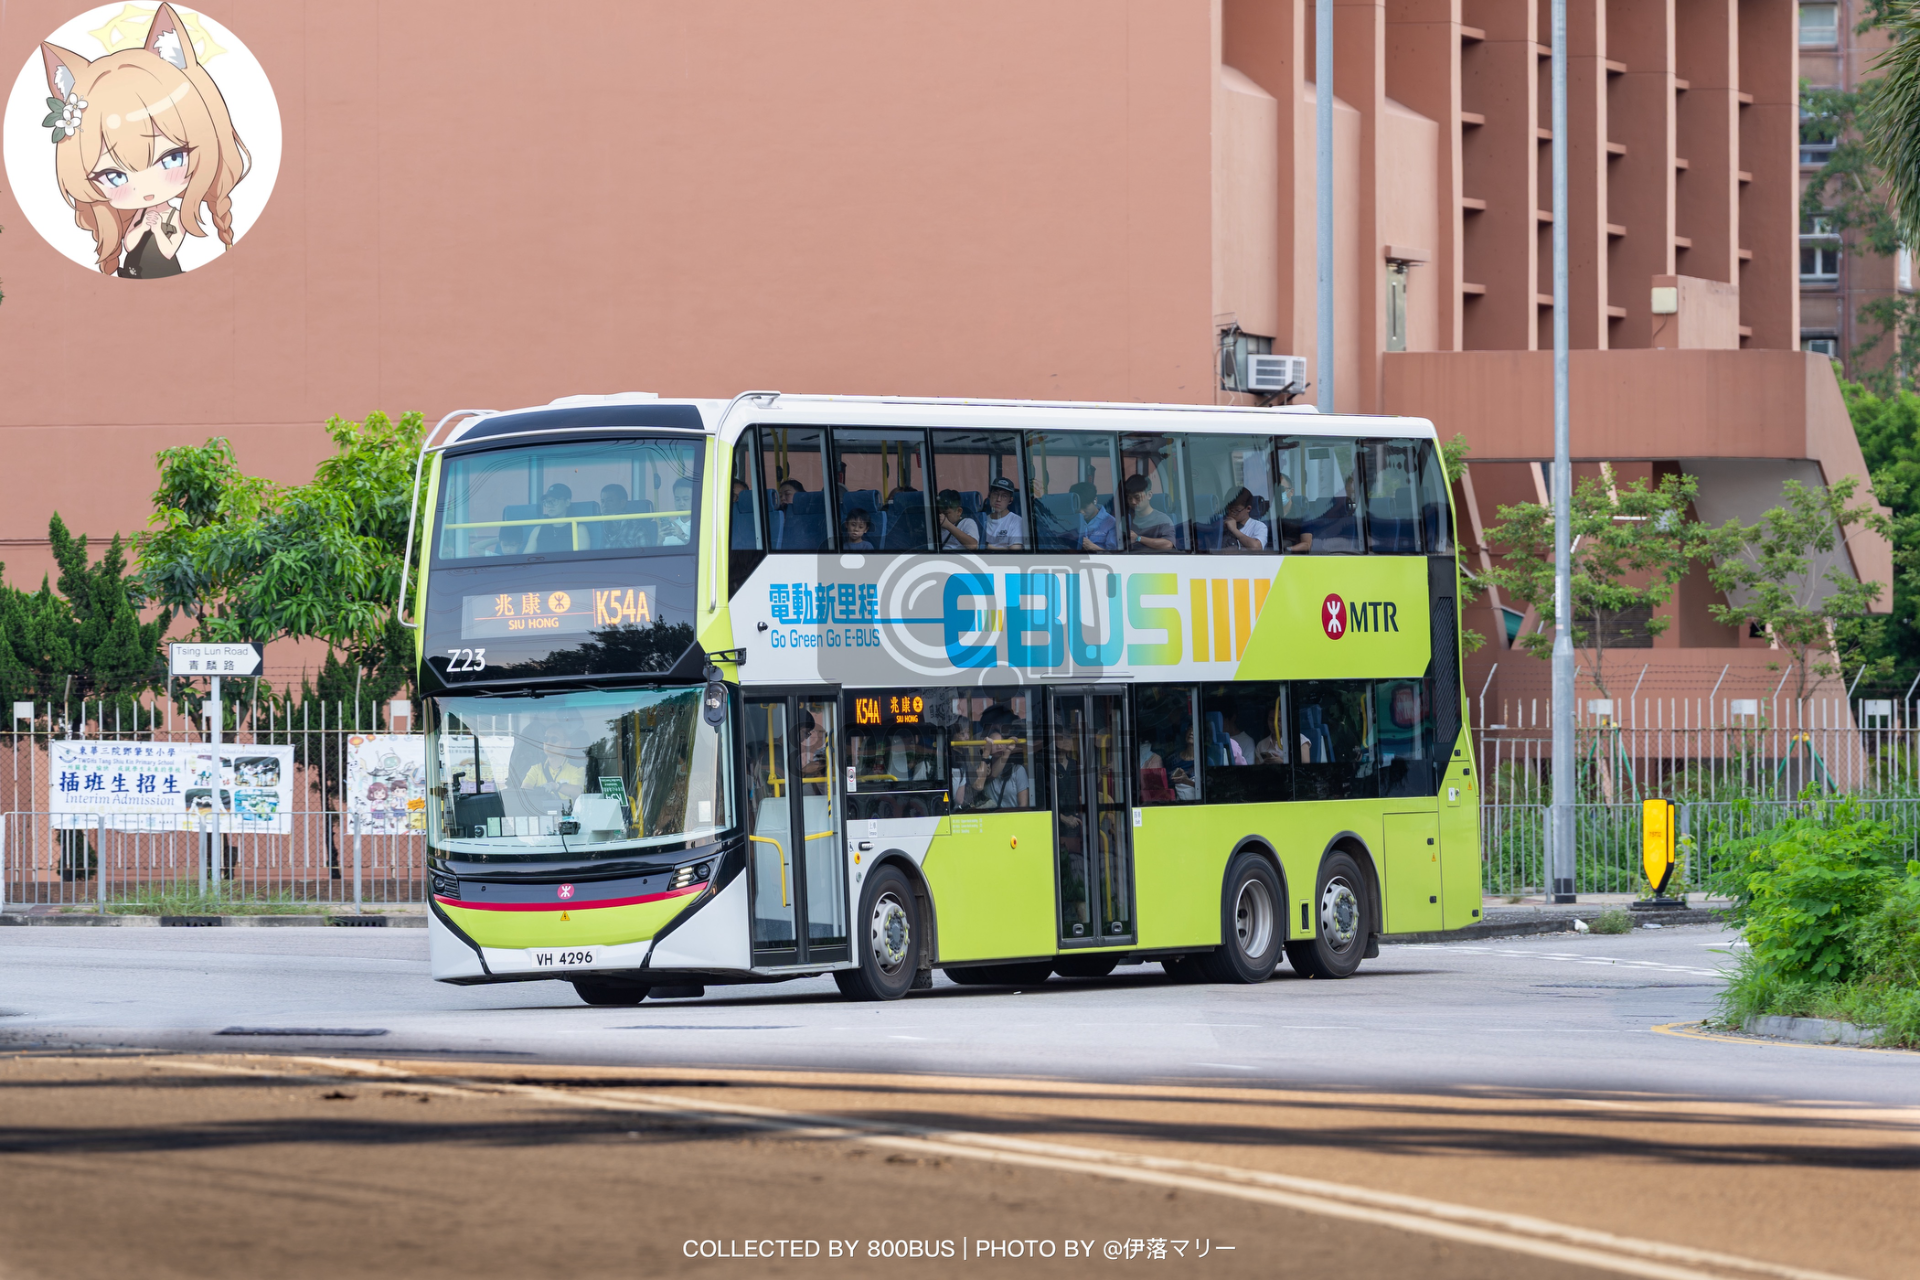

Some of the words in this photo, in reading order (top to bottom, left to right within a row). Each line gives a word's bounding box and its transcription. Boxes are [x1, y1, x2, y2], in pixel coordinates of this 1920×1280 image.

[494, 592, 541, 617] 兆康
[596, 589, 650, 625] K54A
[769, 582, 878, 625] 電動新里程
[508, 619, 525, 630] SIU
[528, 617, 559, 629] HONG
[1350, 601, 1399, 633] MTR
[771, 629, 786, 648] Go
[790, 629, 823, 648] Green
[826, 629, 841, 648] Go
[845, 628, 880, 648] E-BUS
[176, 646, 201, 657] Tsing
[204, 646, 221, 656] Lun
[224, 646, 248, 656] Road
[446, 648, 486, 673] Z23
[856, 698, 879, 724] K54A
[890, 696, 911, 713] 兆康
[904, 714, 918, 723] HONG
[59, 771, 181, 794] 插班生招生
[65, 792, 110, 804] Interim
[112, 794, 175, 806] Admission
[536, 953, 553, 966] VH
[559, 951, 593, 965] 4296
